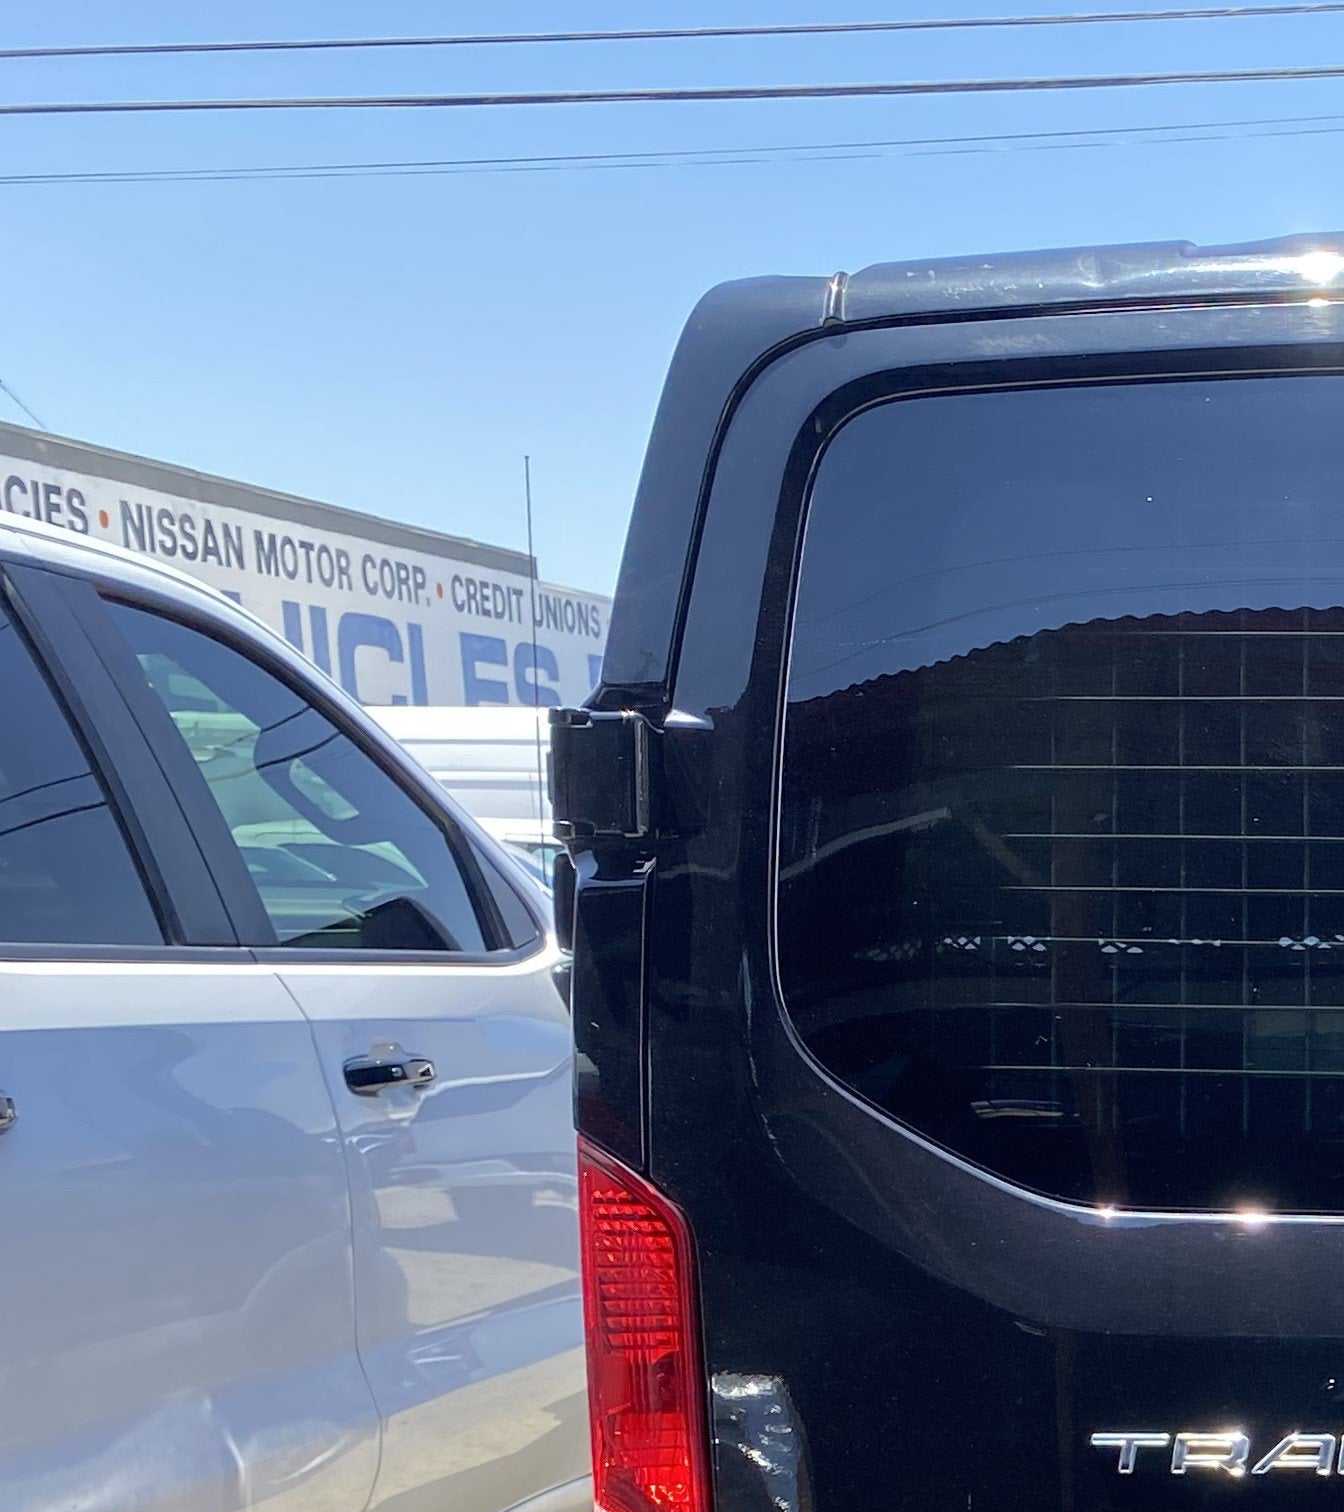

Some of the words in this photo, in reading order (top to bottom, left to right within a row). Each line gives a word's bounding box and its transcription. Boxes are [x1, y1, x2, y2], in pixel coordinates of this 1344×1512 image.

[0, 475, 90, 535] CIES
[119, 499, 245, 571] NISSAN
[253, 530, 353, 592] MOTOR
[362, 554, 431, 606] CORP.
[451, 574, 525, 624] CREDIT
[531, 591, 601, 639] UNIONS
